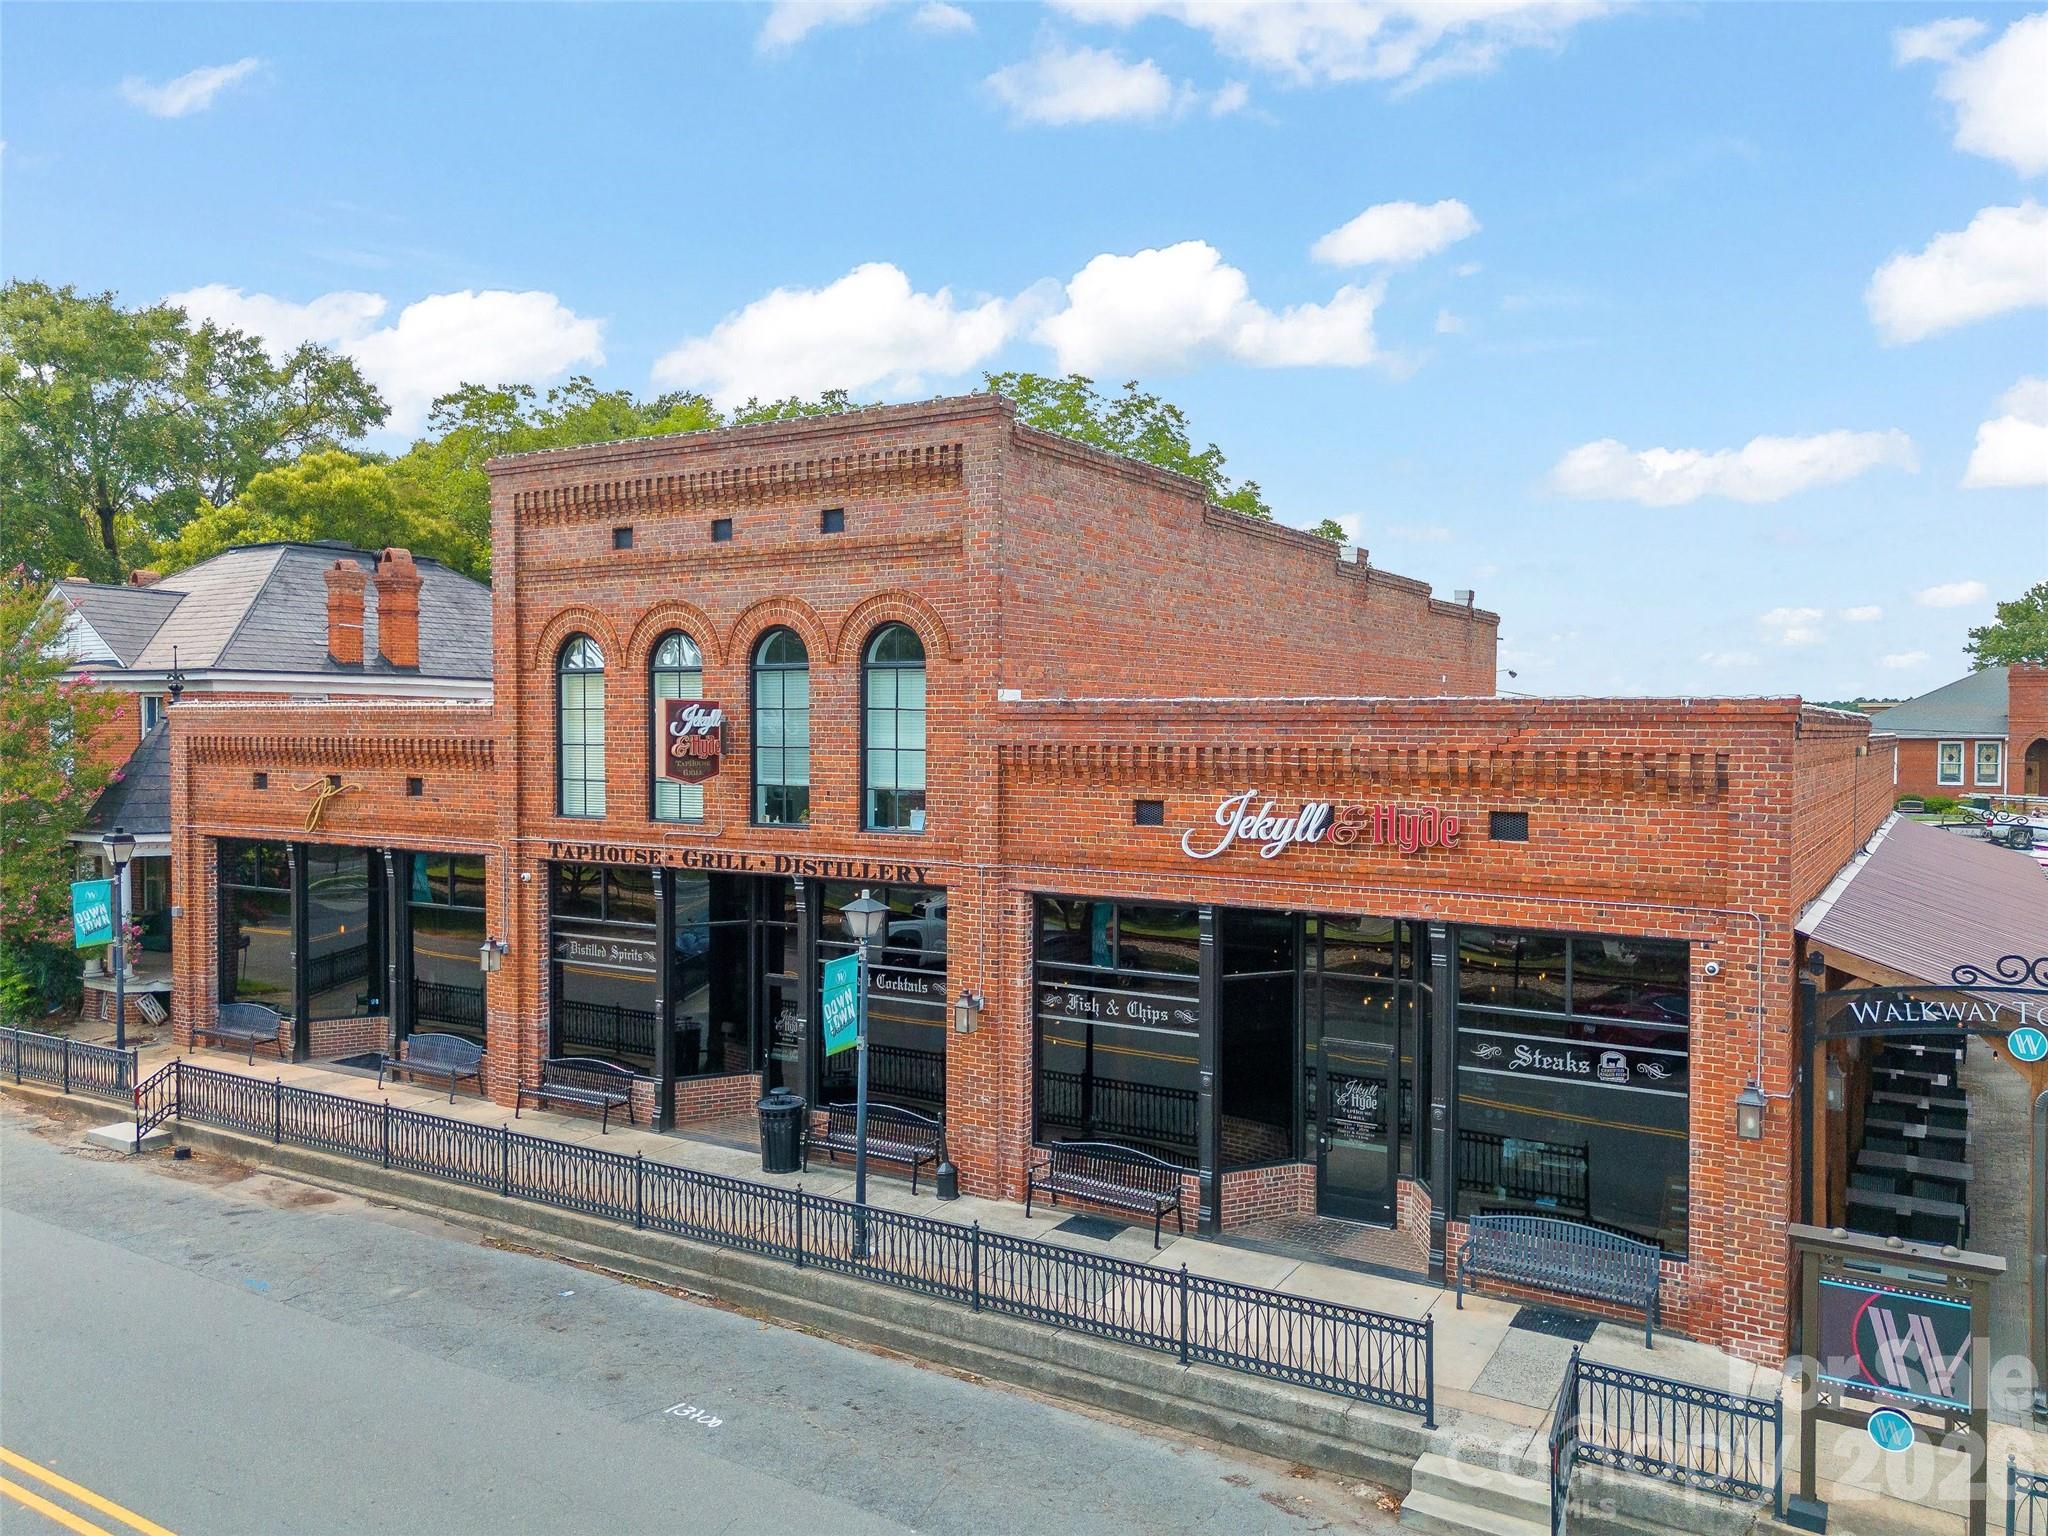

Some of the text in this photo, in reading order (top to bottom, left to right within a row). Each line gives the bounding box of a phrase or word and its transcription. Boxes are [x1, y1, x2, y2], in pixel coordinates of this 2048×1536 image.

[670, 703, 722, 736] Jekyll
[671, 735, 720, 760] & Hyde
[1181, 789, 1460, 859] Jekyll & Hyde
[548, 842, 931, 884] TAPHOUSE GRILL DISTILLERY
[75, 902, 107, 924] DOWN
[79, 913, 111, 936] TOWN
[569, 941, 643, 963] Distilled Spirits
[876, 973, 928, 994] Cocktails
[824, 987, 853, 1020] DOWN
[1065, 993, 1169, 1024] Fish & Chips
[1848, 1000, 2003, 1025] WALKWAY
[827, 1003, 856, 1036] TOWN
[1508, 1044, 1591, 1074] Steaks
[1335, 1079, 1378, 1098] Jekyll
[1336, 1092, 1377, 1110] & Hyde
